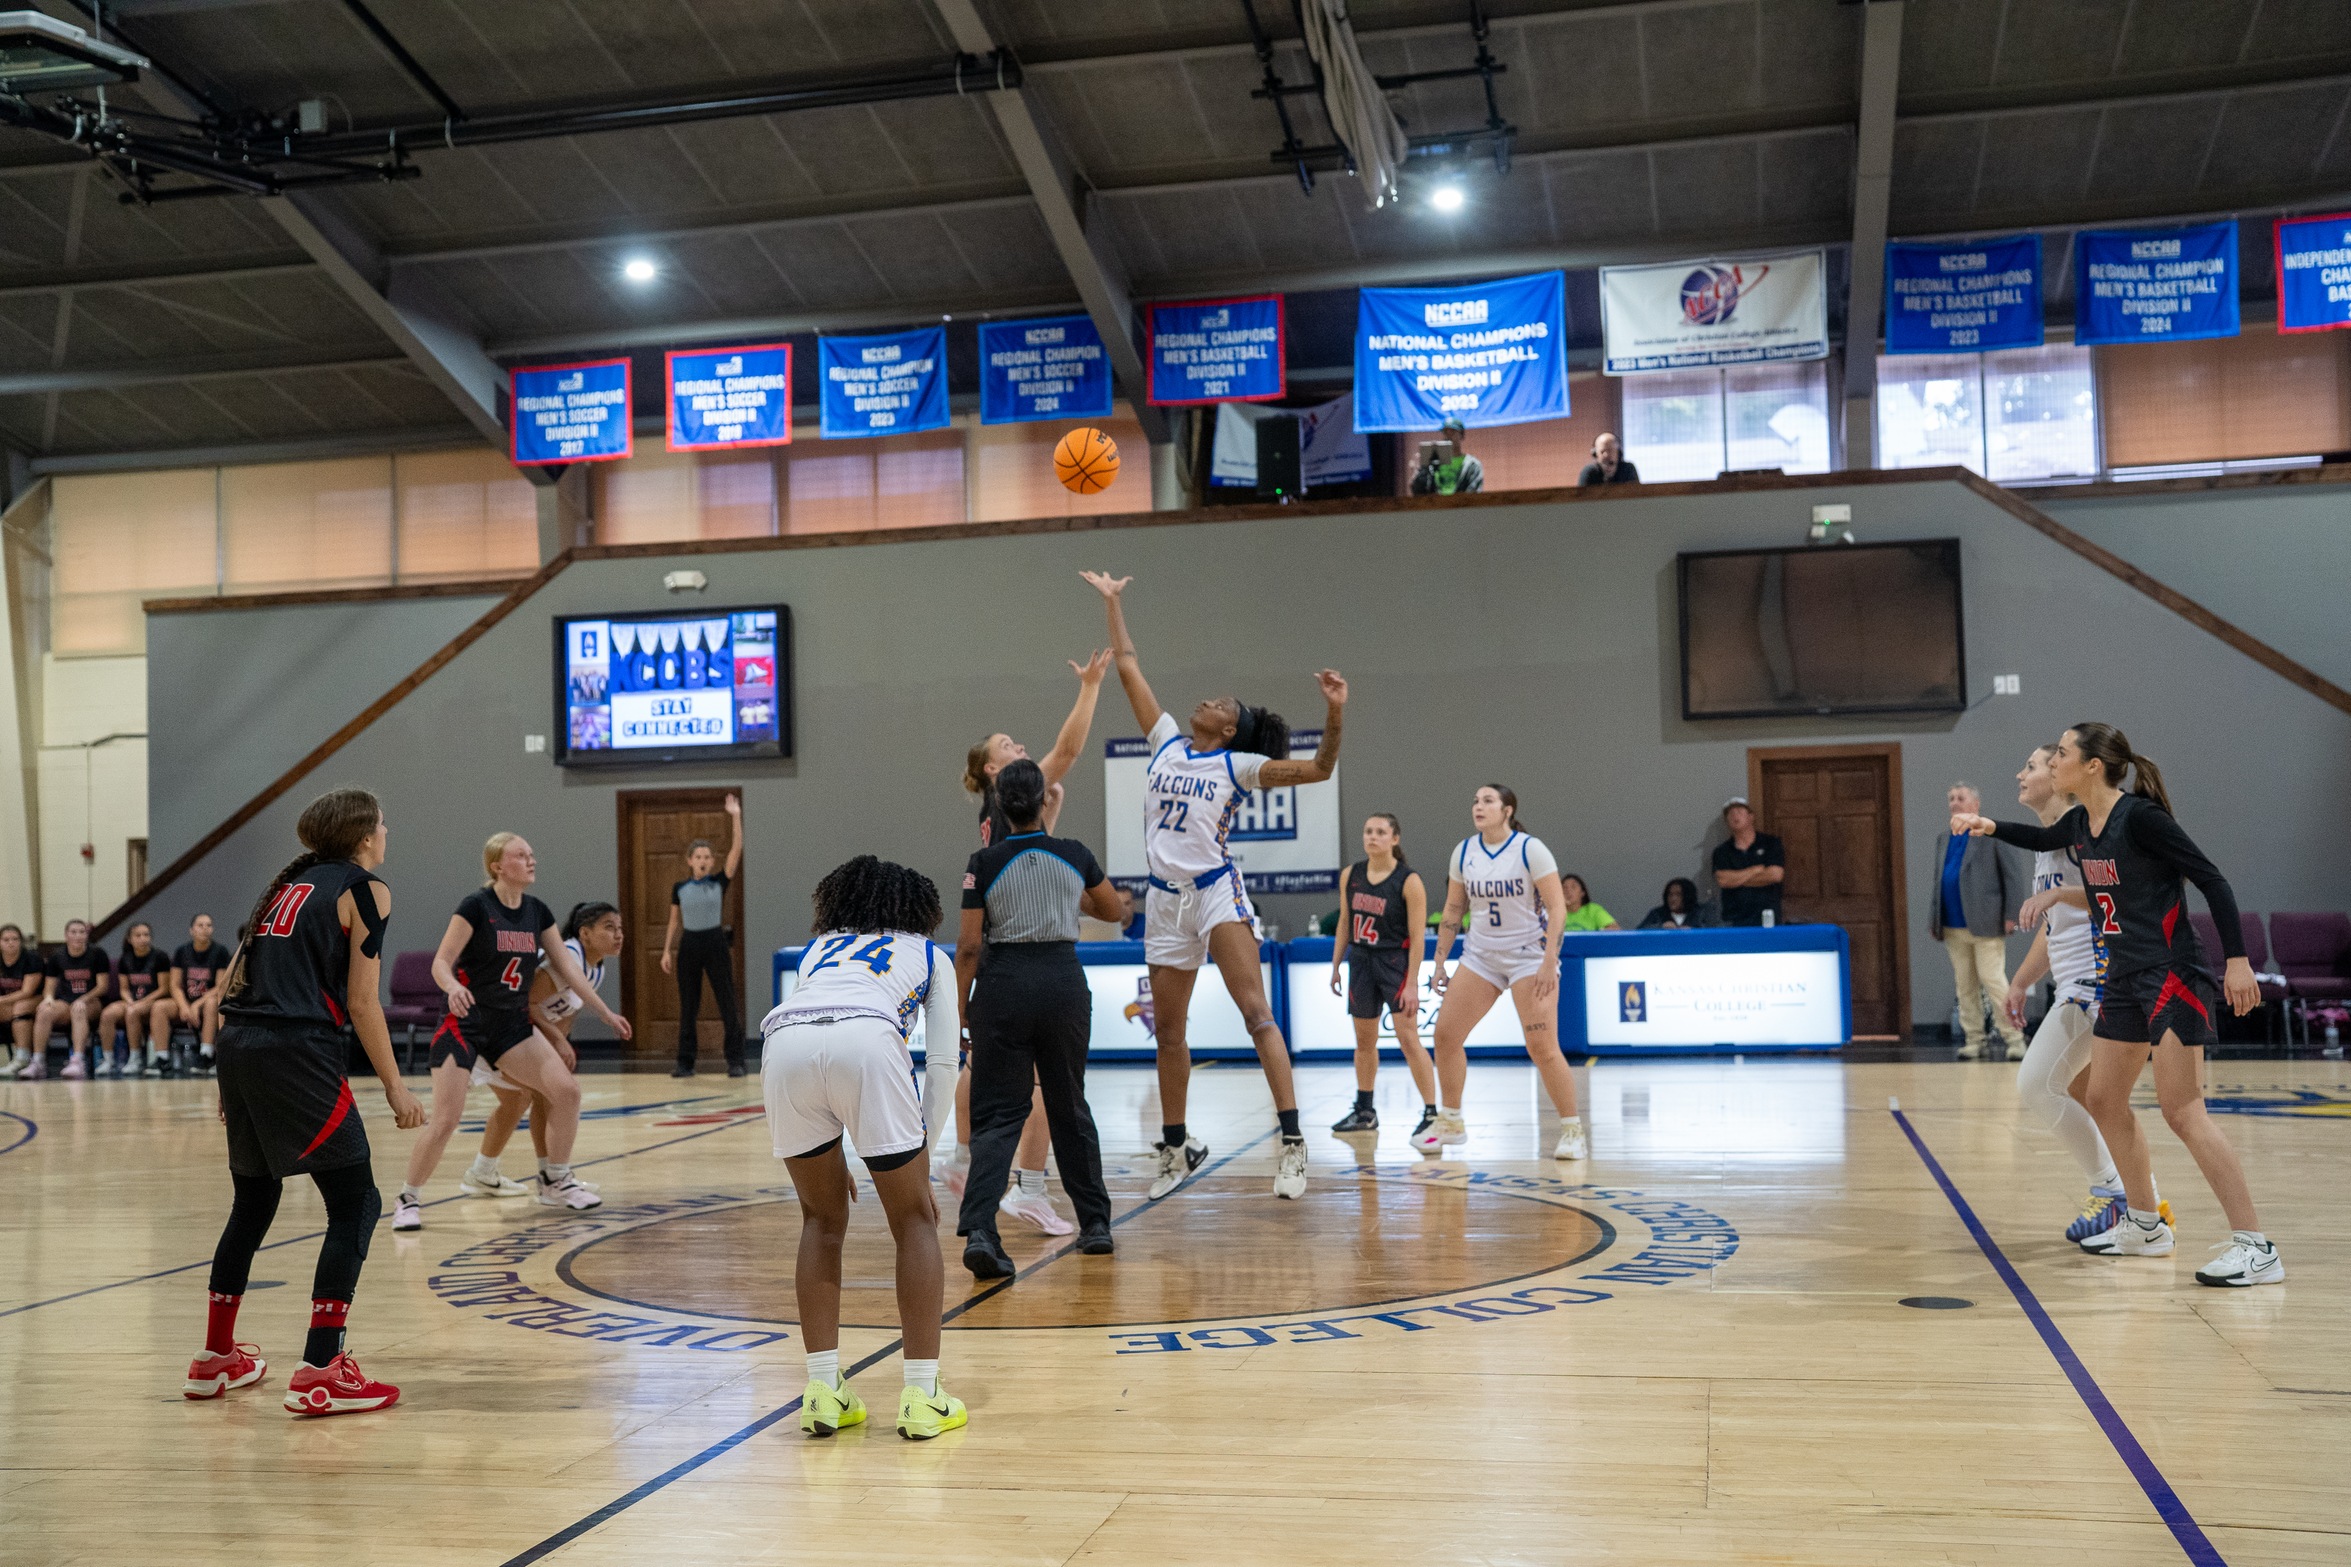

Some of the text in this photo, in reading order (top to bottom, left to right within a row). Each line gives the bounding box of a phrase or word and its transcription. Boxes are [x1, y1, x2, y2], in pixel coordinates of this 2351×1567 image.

[2131, 239, 2181, 259] NCCAA
[2285, 248, 2351, 269] INDEPENDEN
[2089, 257, 2224, 279] REGIONAL CHAMPION
[1894, 268, 2032, 293] REGIONAL CHAMPIONS
[2094, 276, 2218, 298] MEN'S BASKETBALL
[1903, 288, 2023, 311] MEN'S BASKETBALL
[2122, 298, 2179, 315] DIVISION
[1424, 299, 1489, 327] NCCAA
[1931, 311, 1986, 329] DIVISION
[2141, 317, 2172, 333] 2024
[1155, 326, 1277, 349] REGIONAL CHAMPIONS
[1368, 322, 1549, 351] NATIONAL CHAMPIONS
[1950, 329, 1979, 346] 2023
[991, 345, 1101, 367] REGIONAL CHAMPION
[1163, 344, 1267, 365] MEN'S BASKETBALL
[1378, 345, 1540, 372] MEN'S BASKETBALL
[1668, 352, 1710, 367] National
[1711, 347, 1763, 365] Basketball
[1765, 341, 1821, 359] Champions
[829, 358, 934, 381] REGIONAL CHAMPION
[1008, 362, 1084, 382] MEN'S SOCCER
[1186, 363, 1236, 380] DIVISION
[675, 374, 785, 396] REGIONAL CHAMPIONS
[844, 376, 919, 397] MEN'S SOCCER
[1018, 380, 1064, 397] DIVISION
[1203, 380, 1230, 396] 2021
[1417, 371, 1489, 392] DIVISION
[518, 388, 625, 412] REGIONAL CHAMPIONS
[692, 391, 767, 410] MEN'S SOCCER
[854, 396, 900, 412] DIVISION
[1440, 393, 1479, 412] 2023
[536, 406, 608, 426] MEN'S SOCCER
[703, 408, 747, 426] DIVISION
[545, 424, 590, 442] DIVISION
[651, 697, 692, 716] STAY
[623, 718, 723, 737] CONNECTED
[1149, 771, 1218, 802] ALCONS
[1157, 799, 1189, 833] 22
[255, 883, 315, 937] 20
[1488, 902, 1502, 927] 5
[2095, 892, 2123, 935] 2
[1352, 914, 1380, 946] 14
[496, 930, 537, 954] UNION
[808, 933, 897, 979] 24
[500, 956, 523, 992] 4
[1653, 981, 1808, 996] KANSAS CHRISTIAN
[1693, 1000, 1766, 1013] COLLEGE
[1577, 1200, 1740, 1287] CHRISTIAN
[428, 1270, 791, 1352] OVERLAND
[1109, 1286, 1615, 1355] COLLEGE
